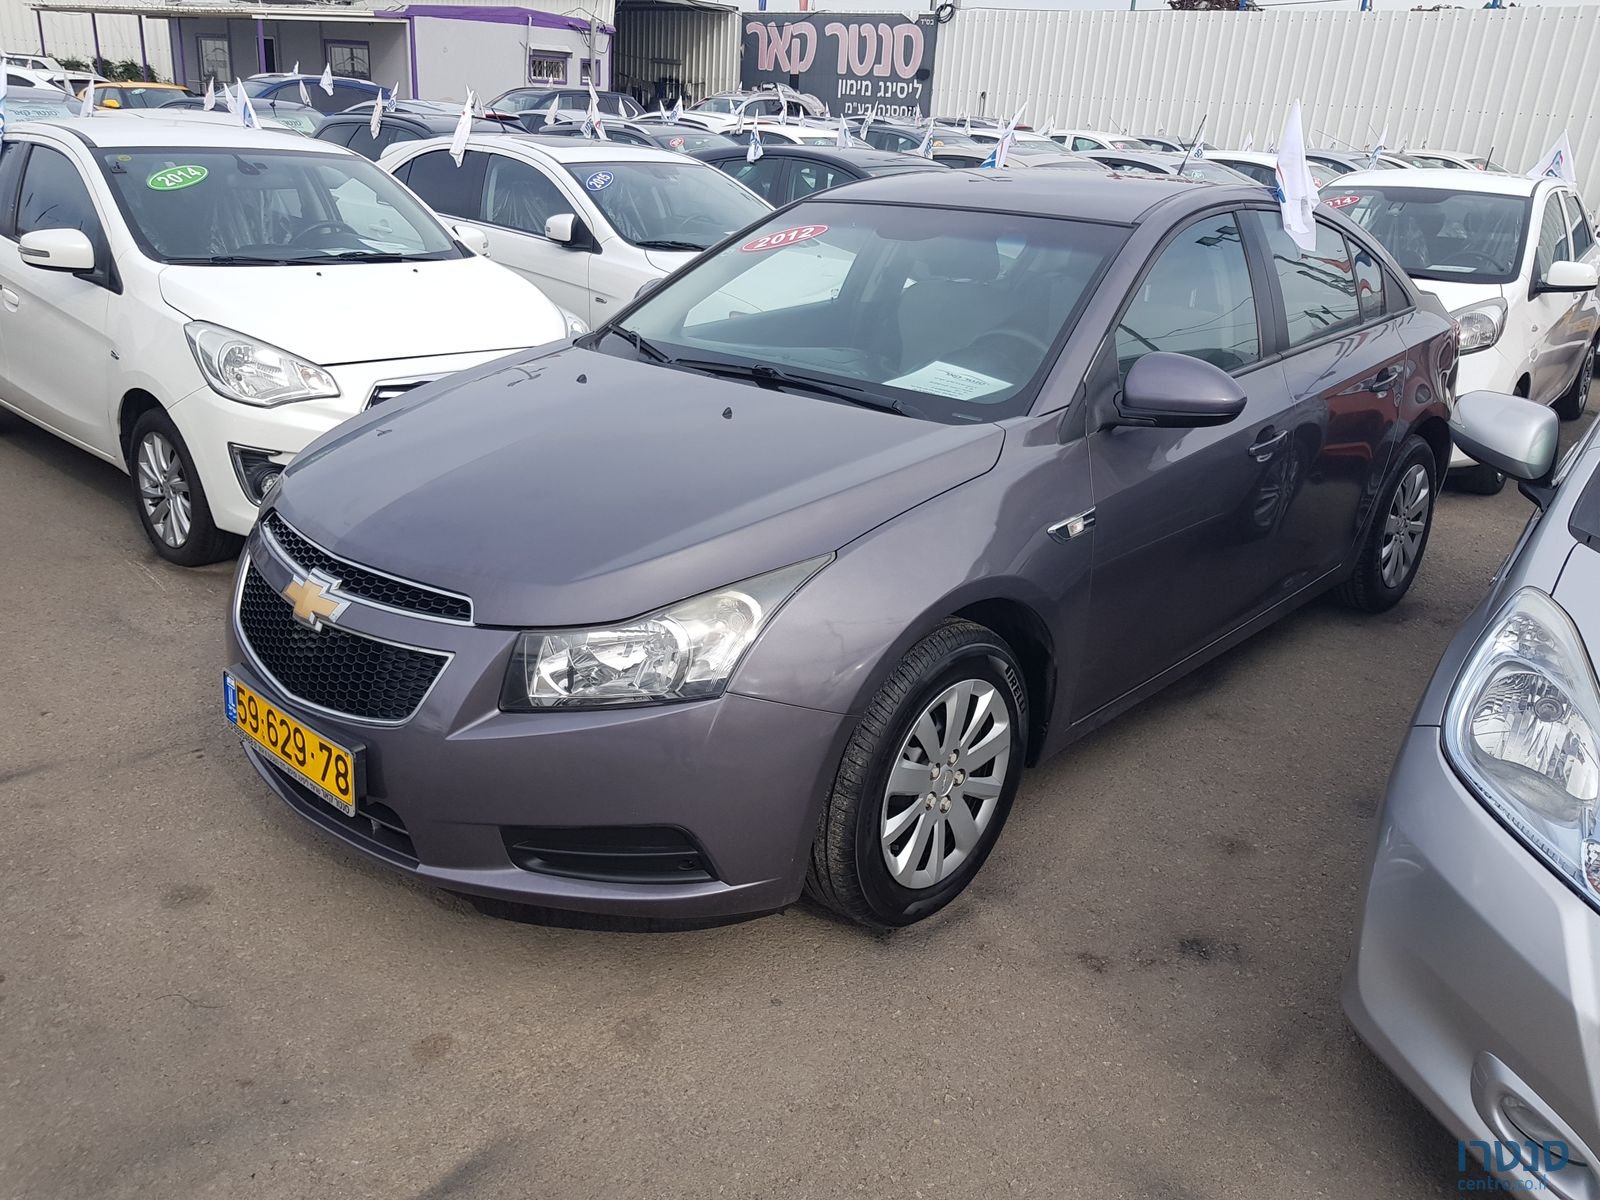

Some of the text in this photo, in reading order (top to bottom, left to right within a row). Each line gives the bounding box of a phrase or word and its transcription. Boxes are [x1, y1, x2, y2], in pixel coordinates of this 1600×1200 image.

[745, 21, 924, 79] סנטר קאר
[838, 79, 923, 99] ליסינג מימון
[157, 167, 202, 187] 2014
[589, 173, 611, 189] 2015
[753, 227, 815, 249] 2012
